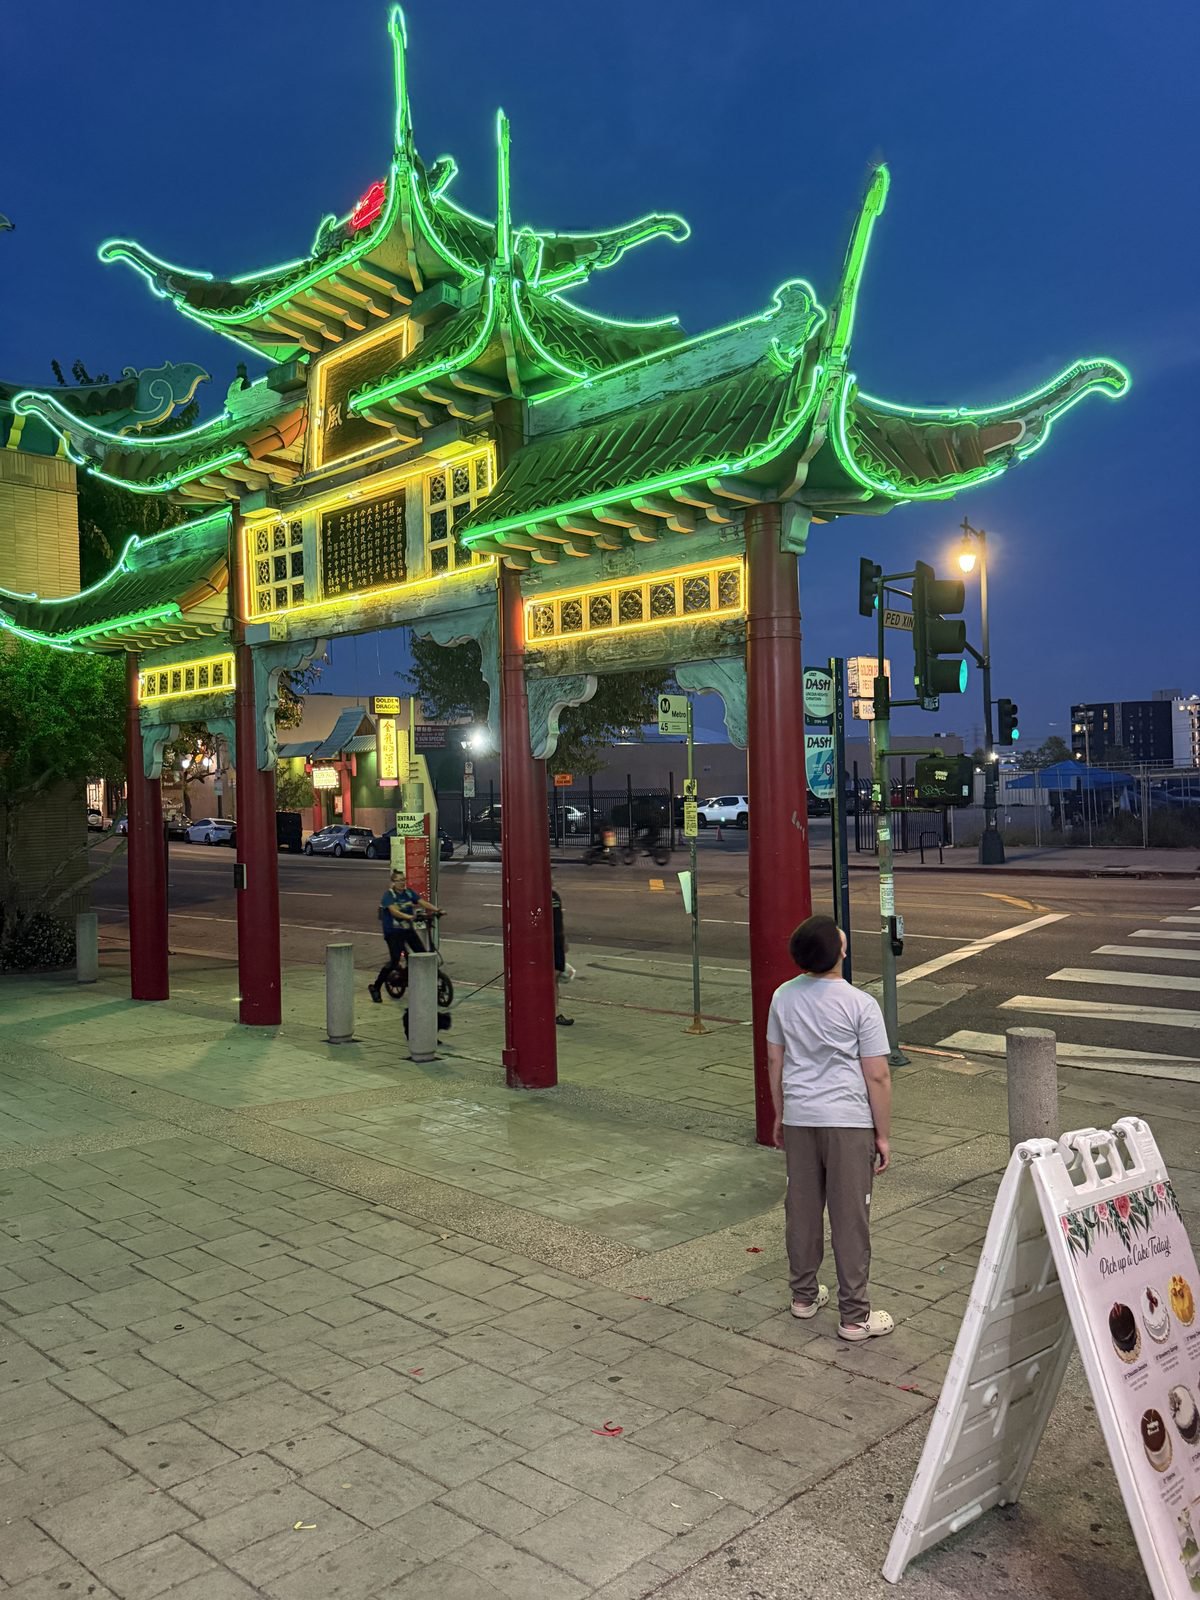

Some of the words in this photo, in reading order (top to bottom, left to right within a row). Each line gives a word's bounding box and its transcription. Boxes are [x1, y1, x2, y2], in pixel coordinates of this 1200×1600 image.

[885, 612, 901, 626] PED
[902, 615, 914, 628] XIN
[805, 678, 831, 691] DASH
[671, 710, 687, 718] Metro
[660, 722, 669, 731] 45
[807, 736, 832, 748] DASH
[1099, 1255, 1117, 1279] Pick
[1117, 1257, 1127, 1274] up
[1127, 1254, 1132, 1266] a
[1132, 1243, 1149, 1266] Cake
